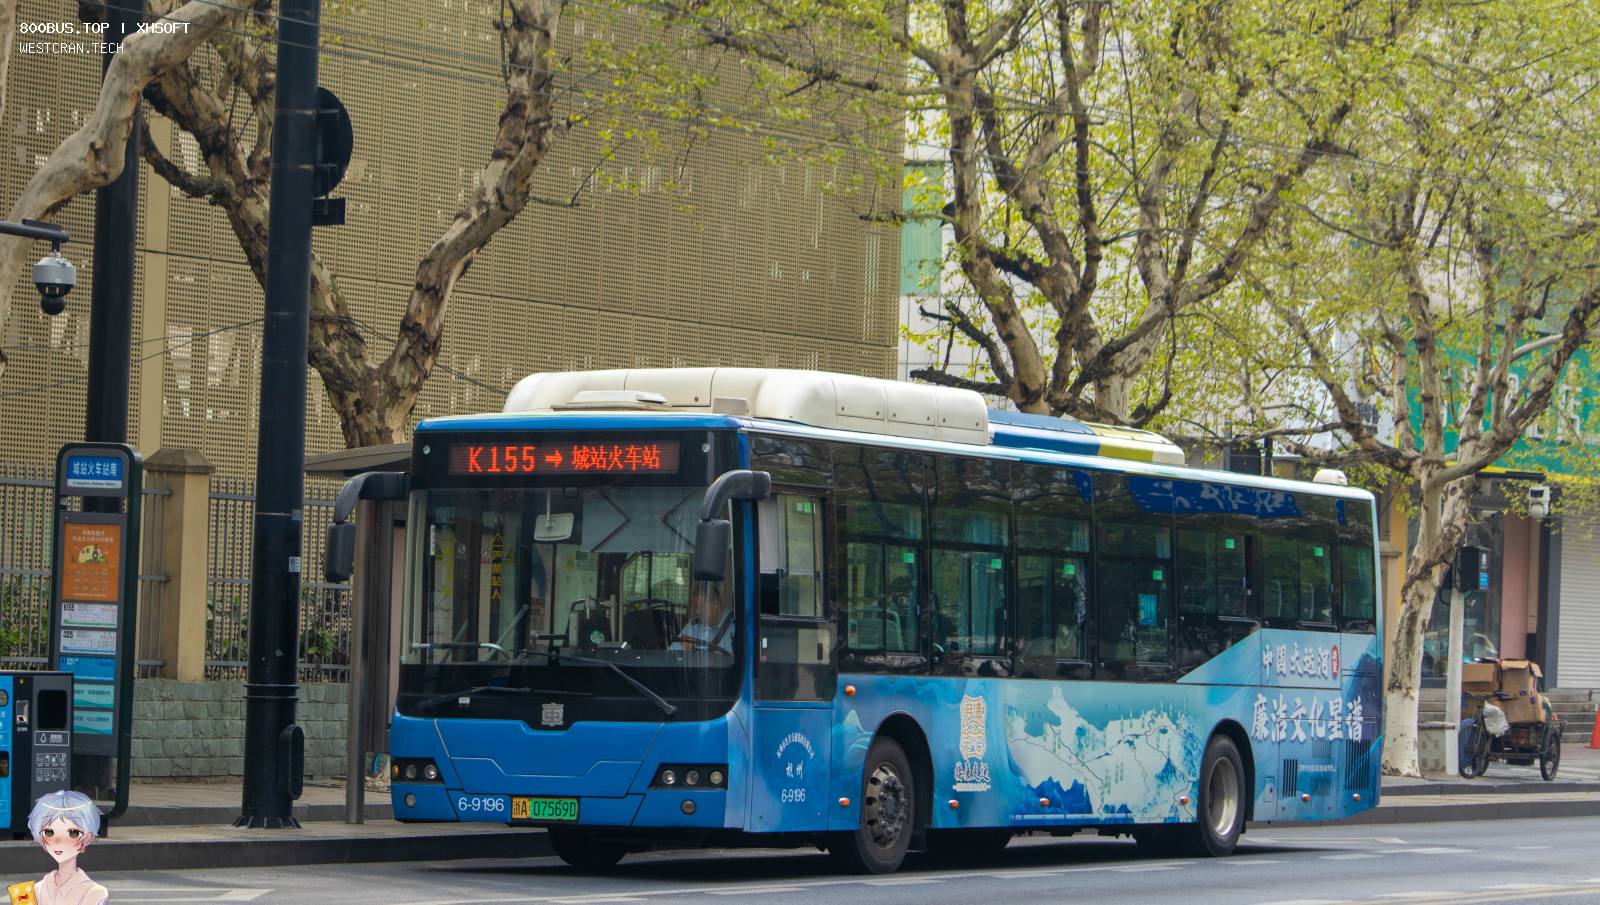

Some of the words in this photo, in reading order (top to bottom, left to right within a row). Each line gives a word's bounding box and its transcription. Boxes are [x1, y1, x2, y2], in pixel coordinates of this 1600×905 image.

[73, 461, 118, 477] 城站火车站南
[467, 446, 536, 473] K155
[571, 444, 661, 471] 城站火车站
[1262, 642, 1330, 680] 中国大运河
[1252, 694, 1364, 743] 廉洁文化星谱
[458, 797, 504, 811] 6-9196
[781, 788, 806, 803] 6-9196
